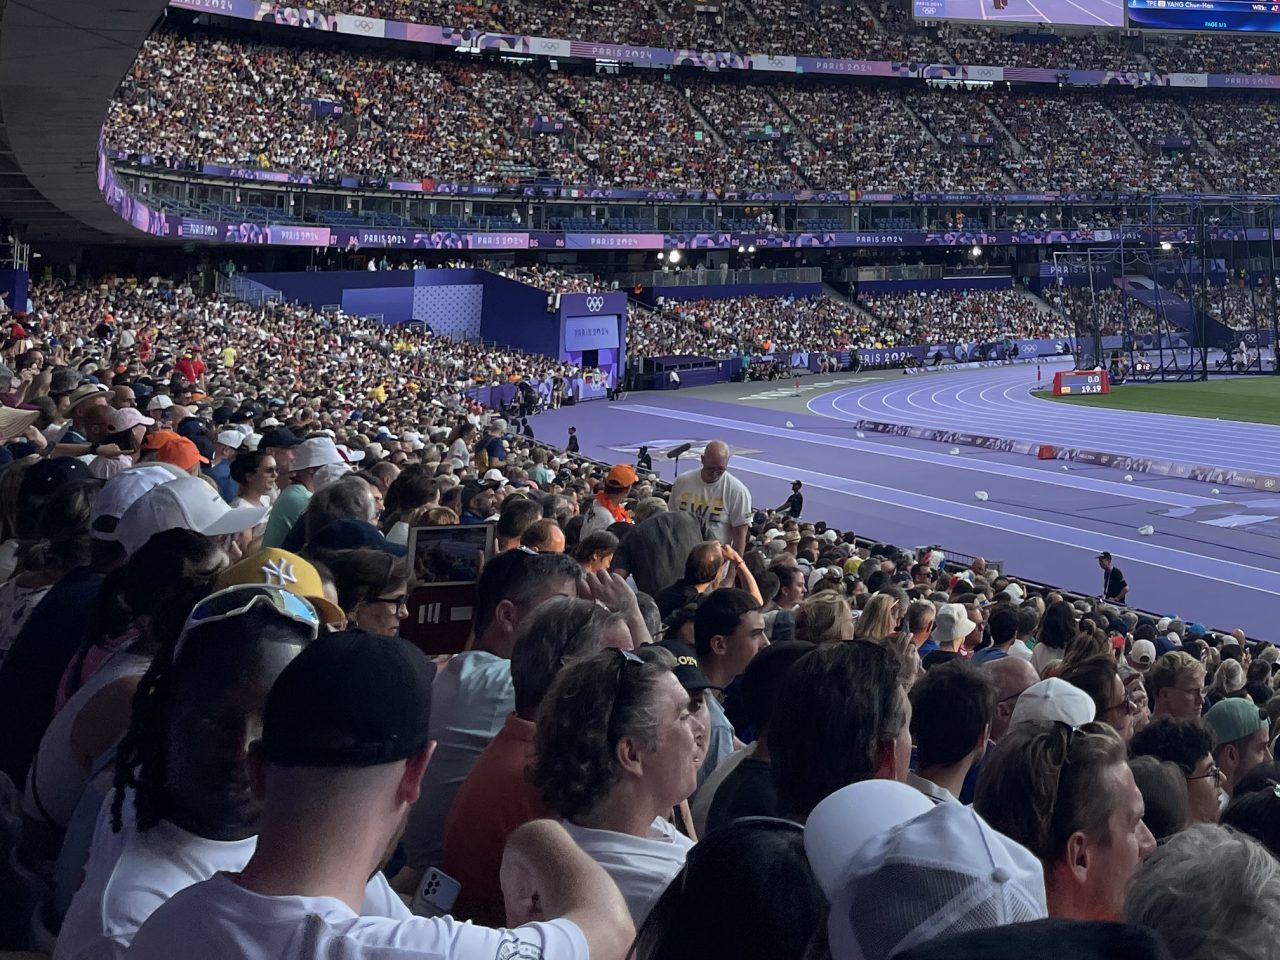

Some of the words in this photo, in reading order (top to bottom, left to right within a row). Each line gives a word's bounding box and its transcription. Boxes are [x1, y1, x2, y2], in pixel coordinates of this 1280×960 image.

[592, 47, 622, 57] PARIS
[624, 50, 652, 59] 2024
[816, 62, 844, 71] PARIS
[847, 63, 872, 72] 2024
[1225, 77, 1250, 85] PARIS
[1252, 77, 1276, 85] 2024
[190, 224, 204, 234] PARIS
[204, 224, 218, 236] 2024
[281, 230, 299, 240] PARIS
[300, 231, 318, 240] 2024
[364, 234, 386, 243] PARIS
[388, 234, 406, 244] 2024
[477, 236, 500, 245] PARIS
[502, 236, 523, 246] 2024
[591, 238, 616, 246] PARIS
[617, 238, 638, 246] 2024
[856, 236, 880, 244] PARIS
[1050, 266, 1080, 274] PARIS
[574, 328, 590, 337] PARIS
[592, 328, 608, 336] 2024
